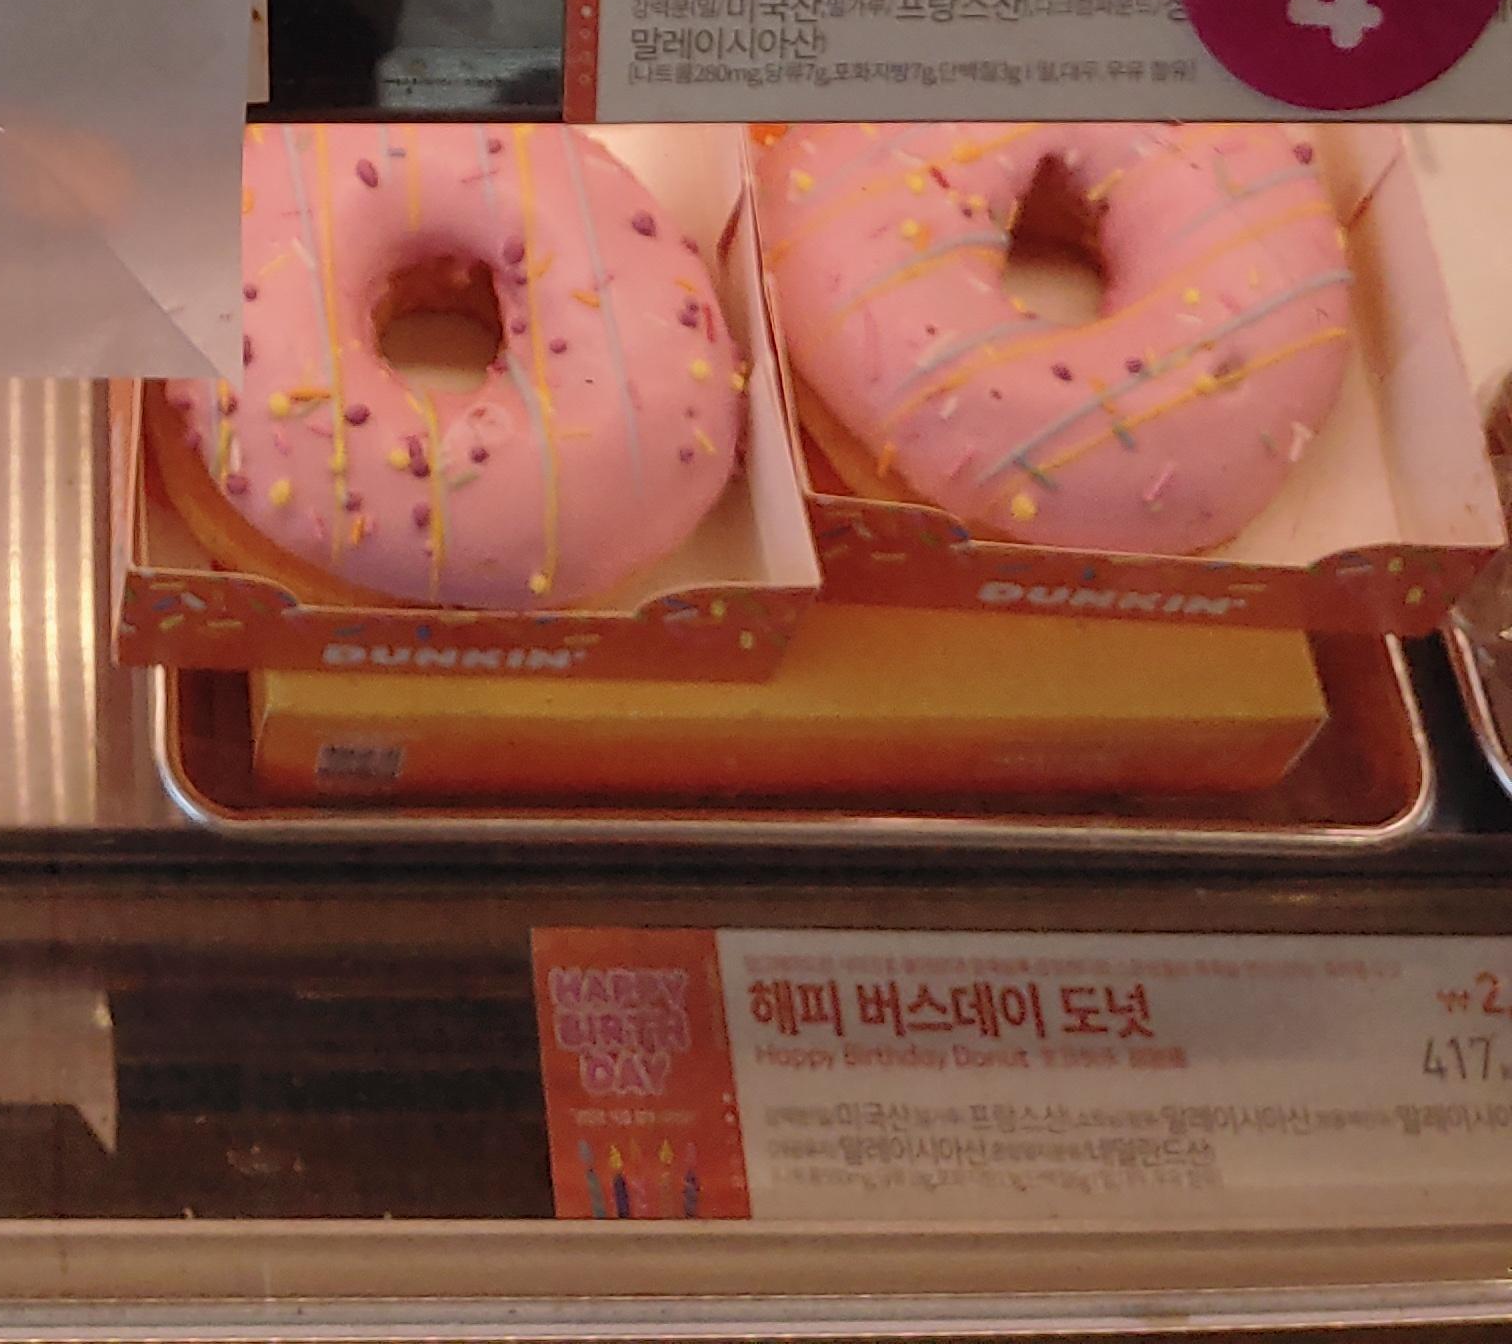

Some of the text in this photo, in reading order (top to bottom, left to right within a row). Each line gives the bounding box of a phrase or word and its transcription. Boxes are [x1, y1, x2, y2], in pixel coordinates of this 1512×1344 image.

[856, 980, 1047, 1038] 버스데이
[1060, 983, 1155, 1039] 도넛
[753, 1043, 835, 1071] Happy
[842, 1044, 946, 1071] Birthday
[1423, 1035, 1494, 1081] 417
